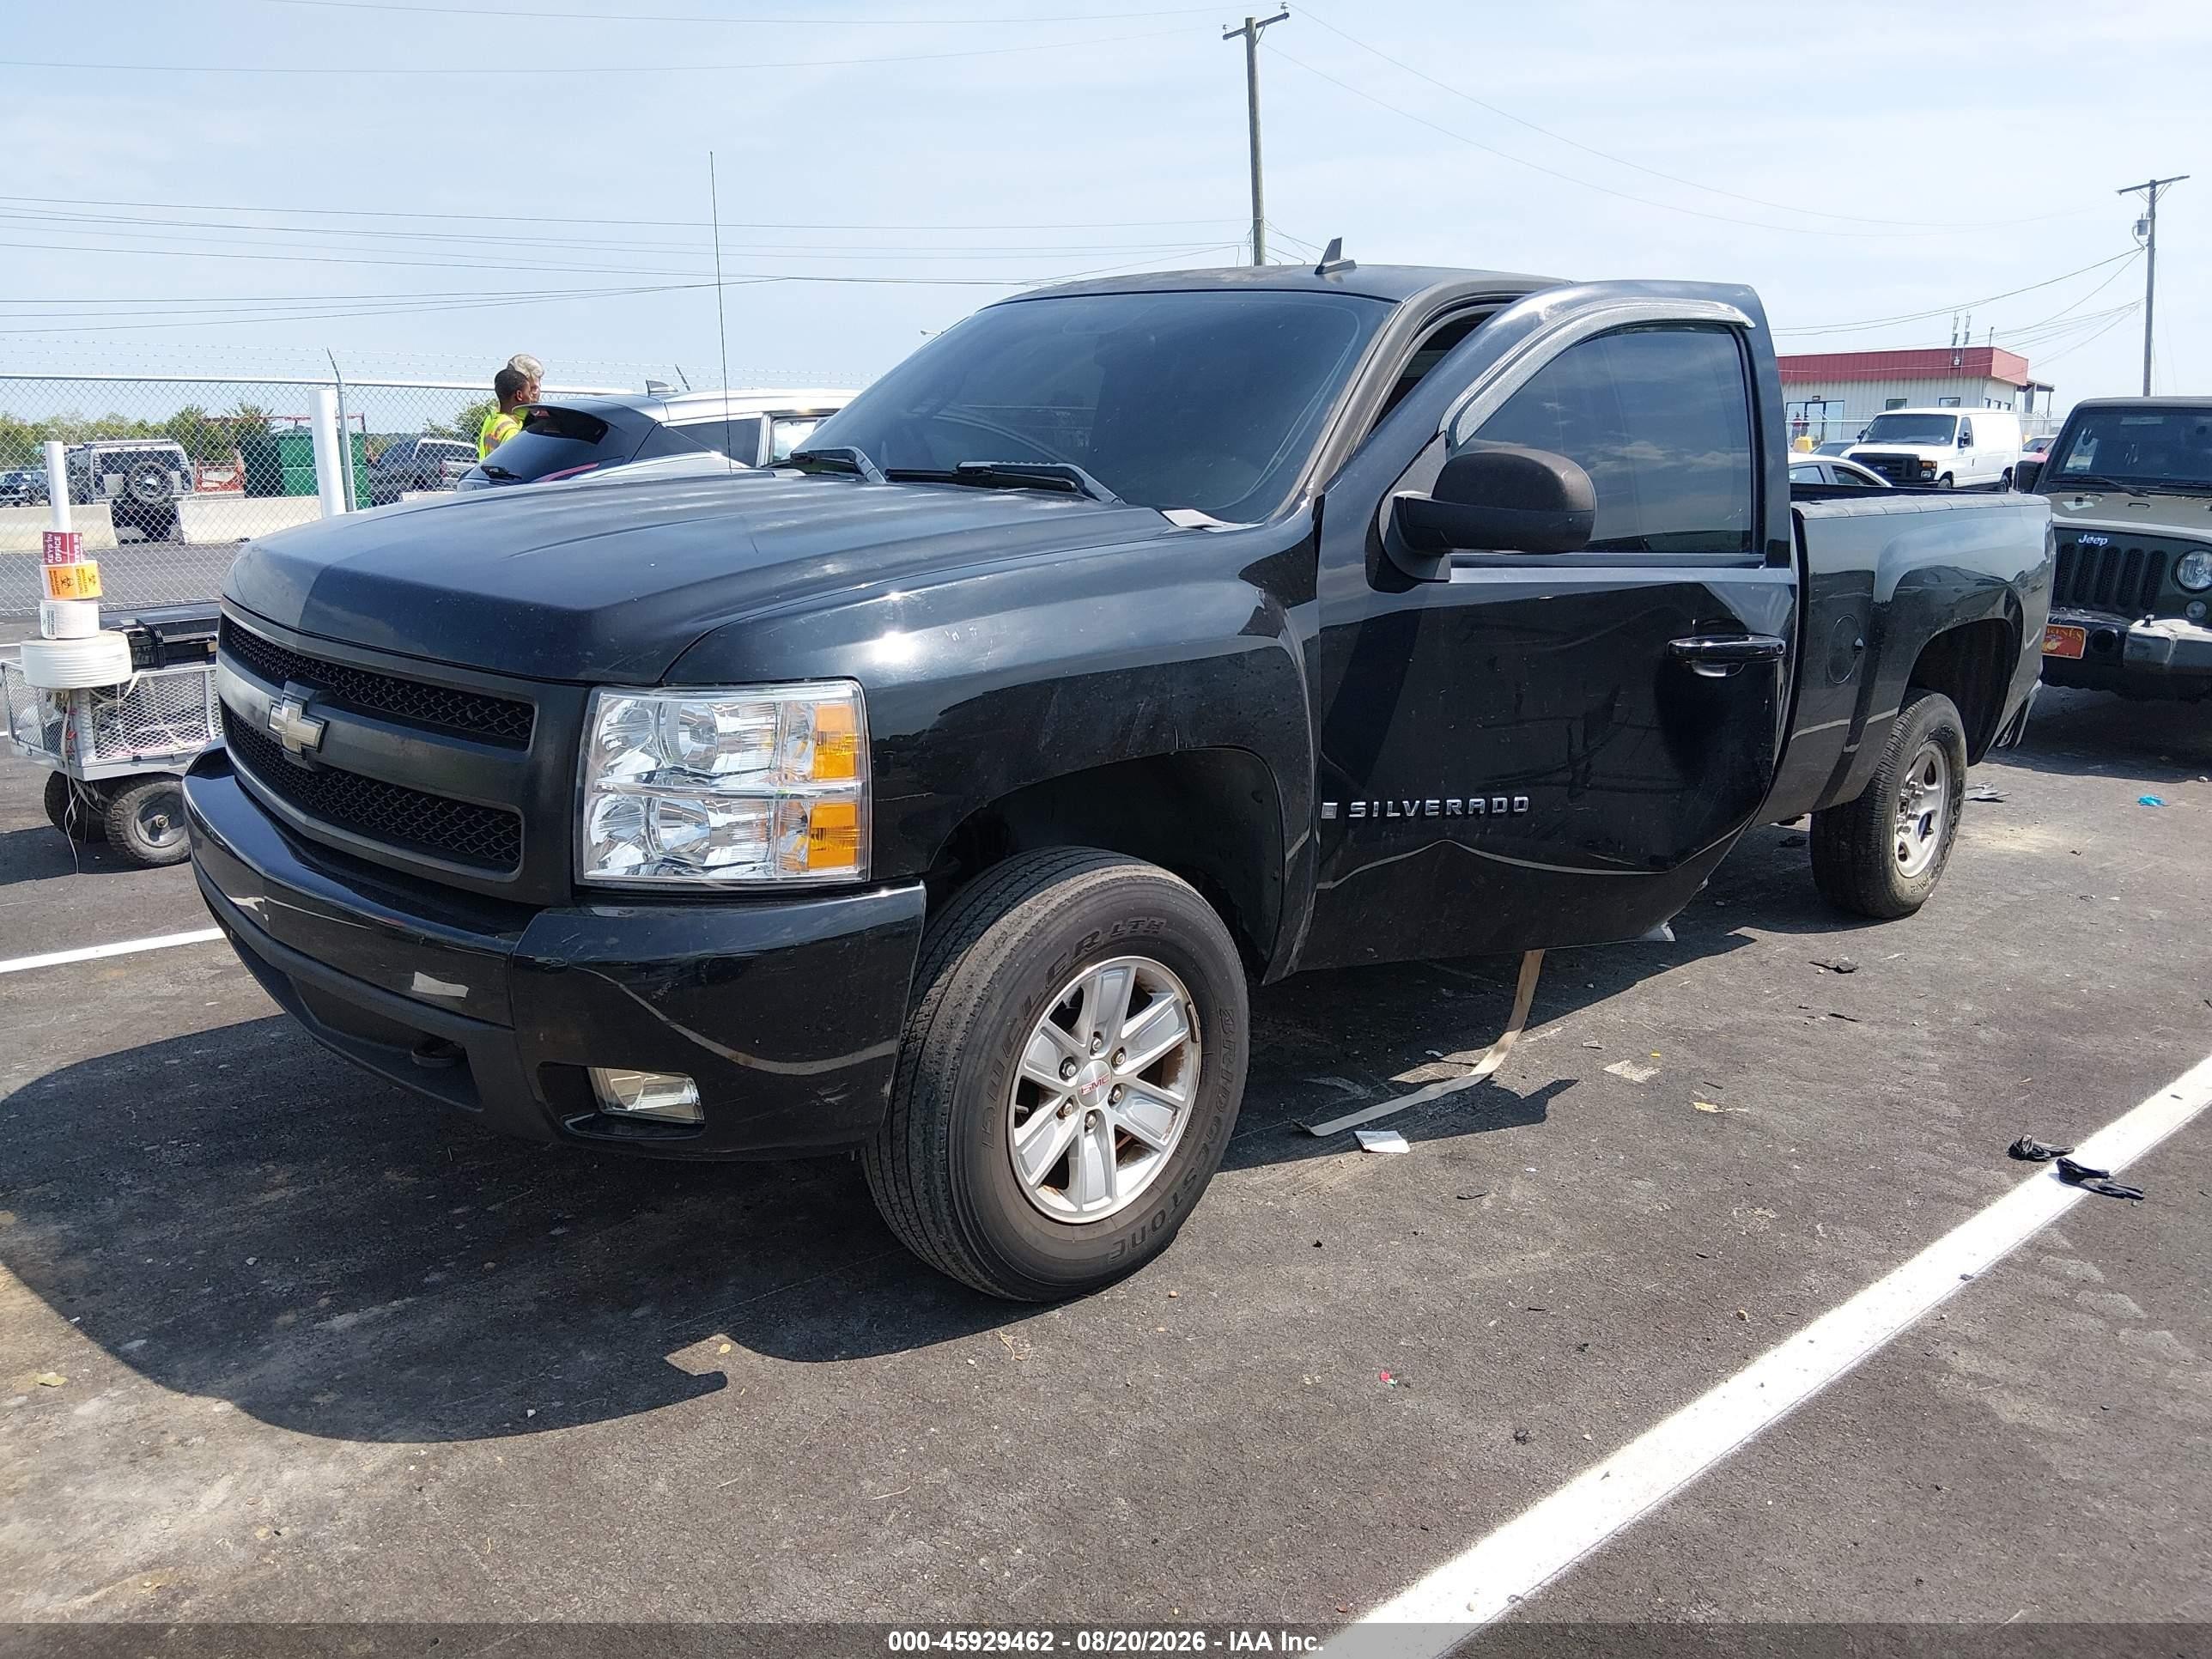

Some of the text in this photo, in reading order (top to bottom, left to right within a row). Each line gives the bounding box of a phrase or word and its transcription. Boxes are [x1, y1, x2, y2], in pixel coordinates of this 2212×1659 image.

[2078, 534, 2108, 546] Jeep
[1348, 796, 1530, 817] SILVERADO
[981, 930, 1103, 1150] DUELER
[1079, 1073, 1110, 1095] GMC
[1106, 1007, 1236, 1263] BRIDGESTONE
